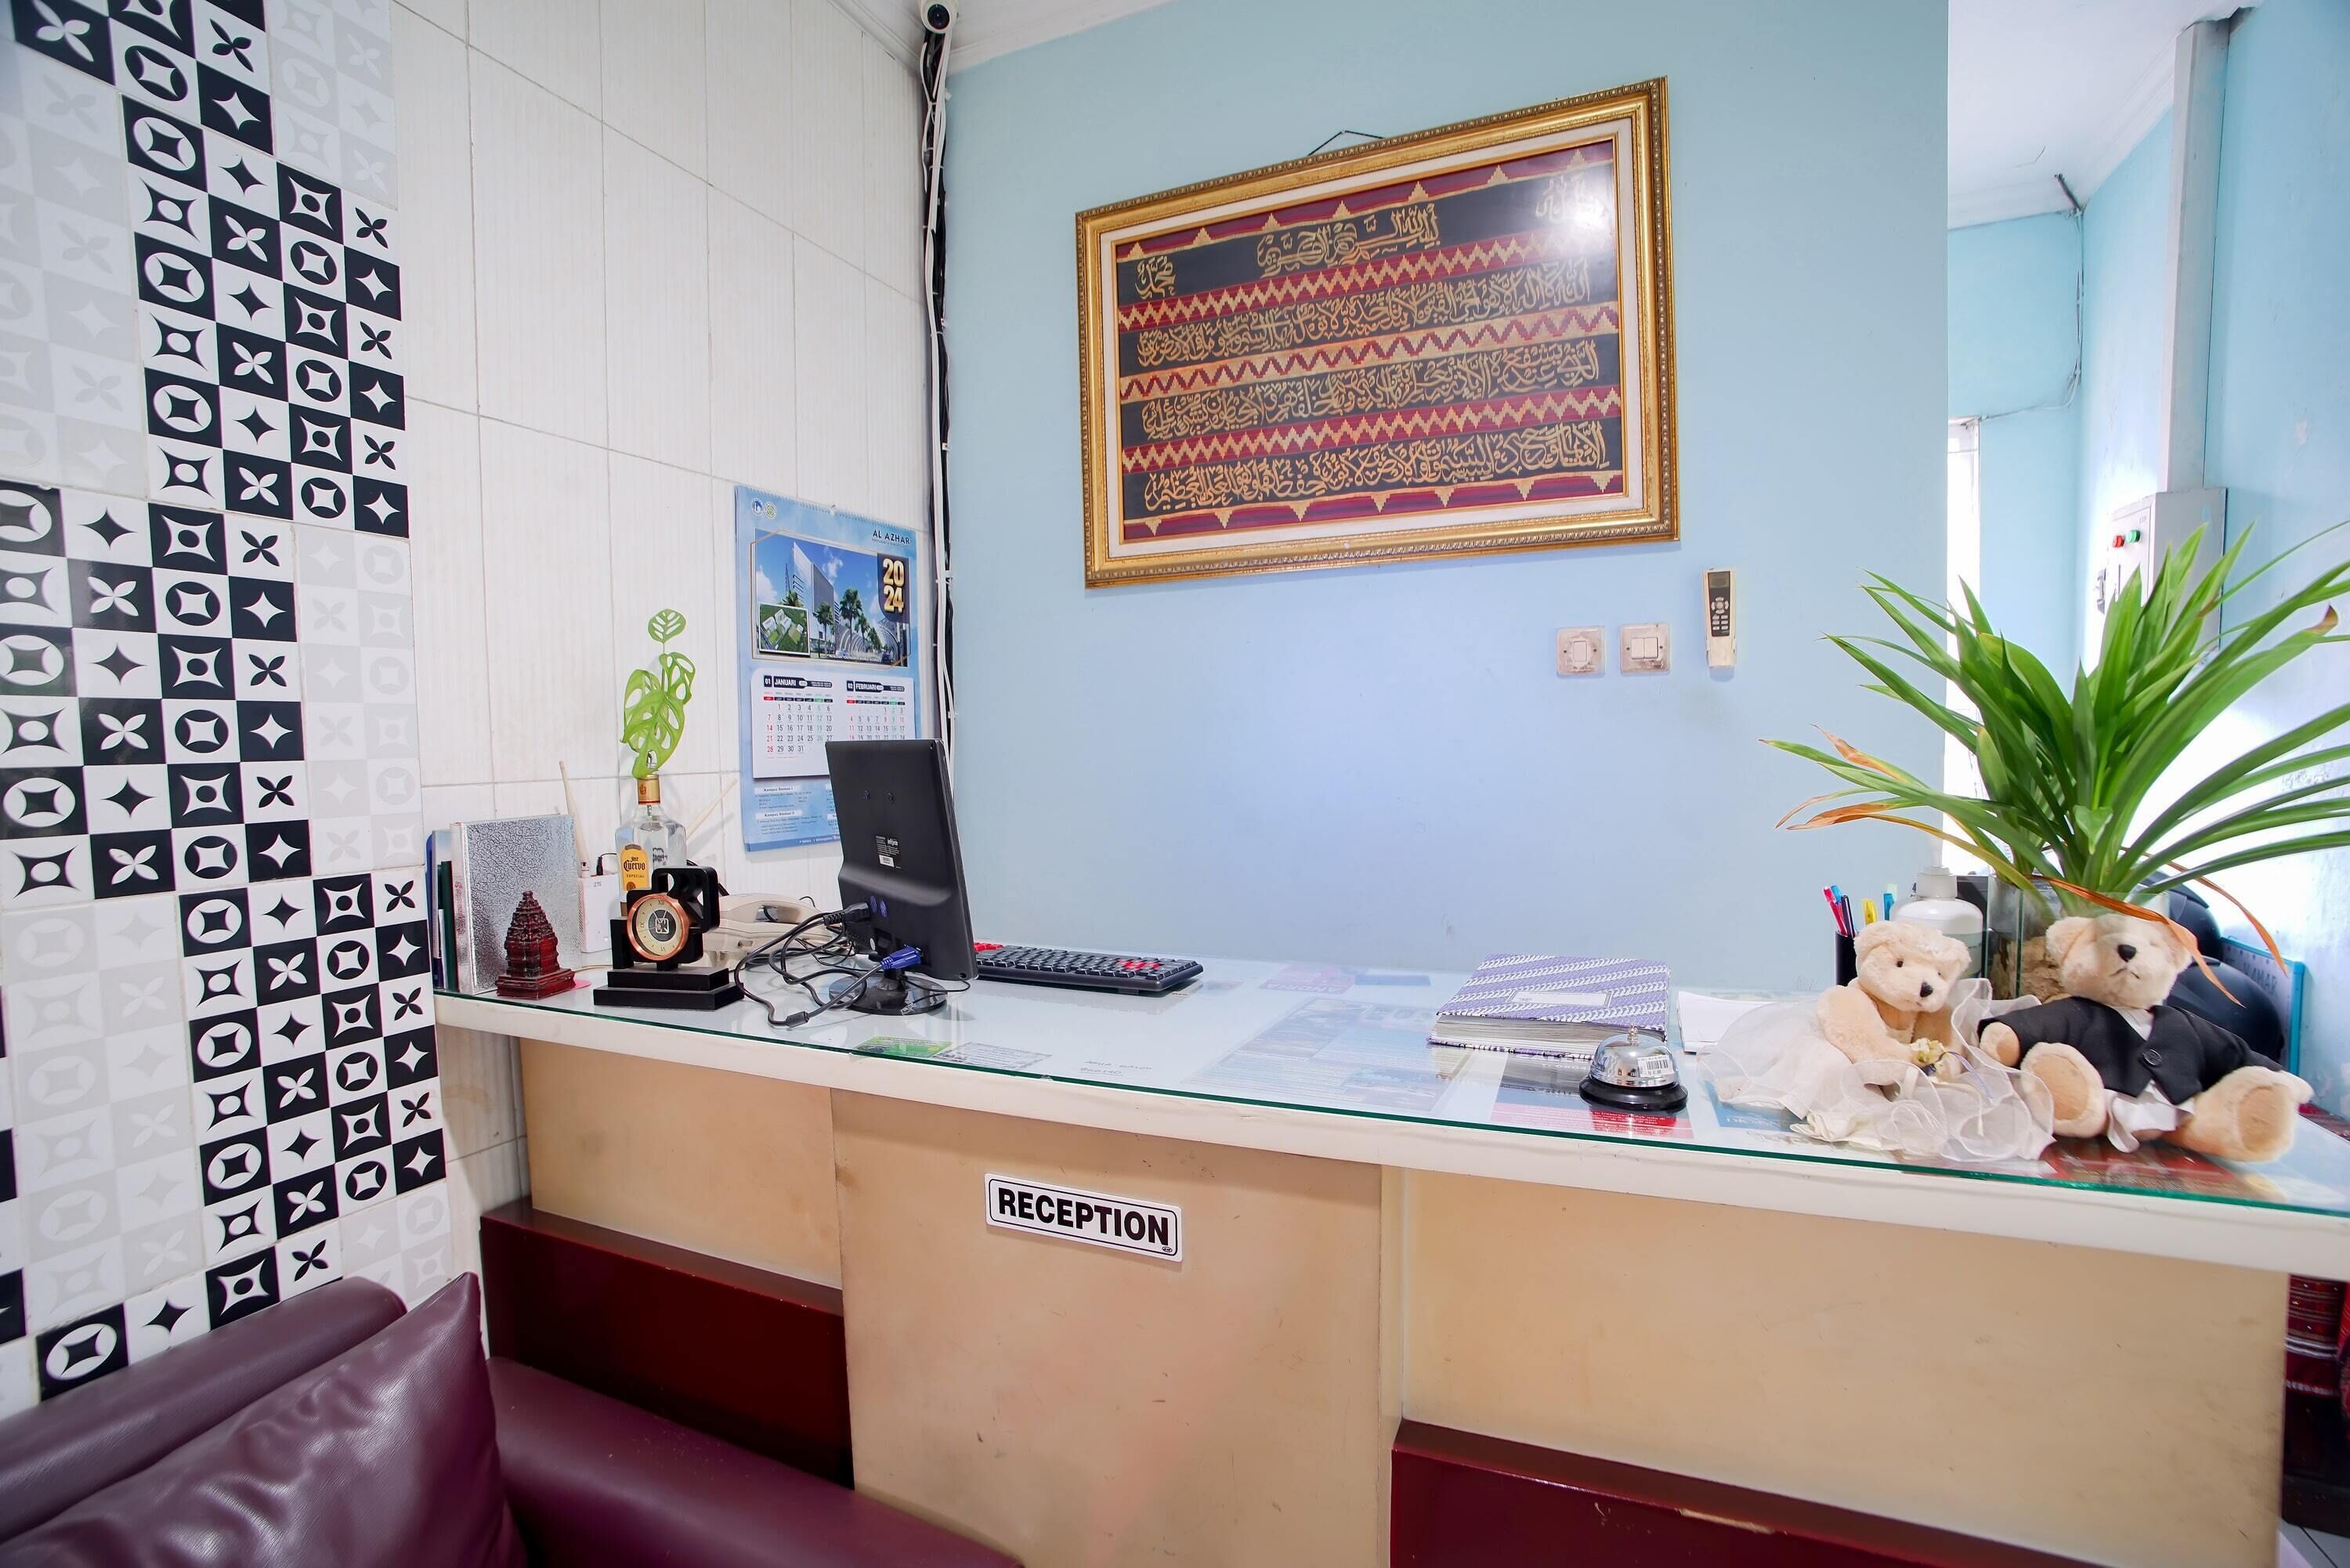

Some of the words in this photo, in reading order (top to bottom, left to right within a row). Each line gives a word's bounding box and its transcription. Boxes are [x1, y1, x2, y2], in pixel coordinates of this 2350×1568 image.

[873, 529, 882, 538] AL
[884, 533, 909, 545] AZHAR
[883, 558, 905, 586] 20
[883, 584, 904, 613] 24
[624, 860, 645, 872] Cuervo
[998, 1187, 1169, 1245] RECEPTION
